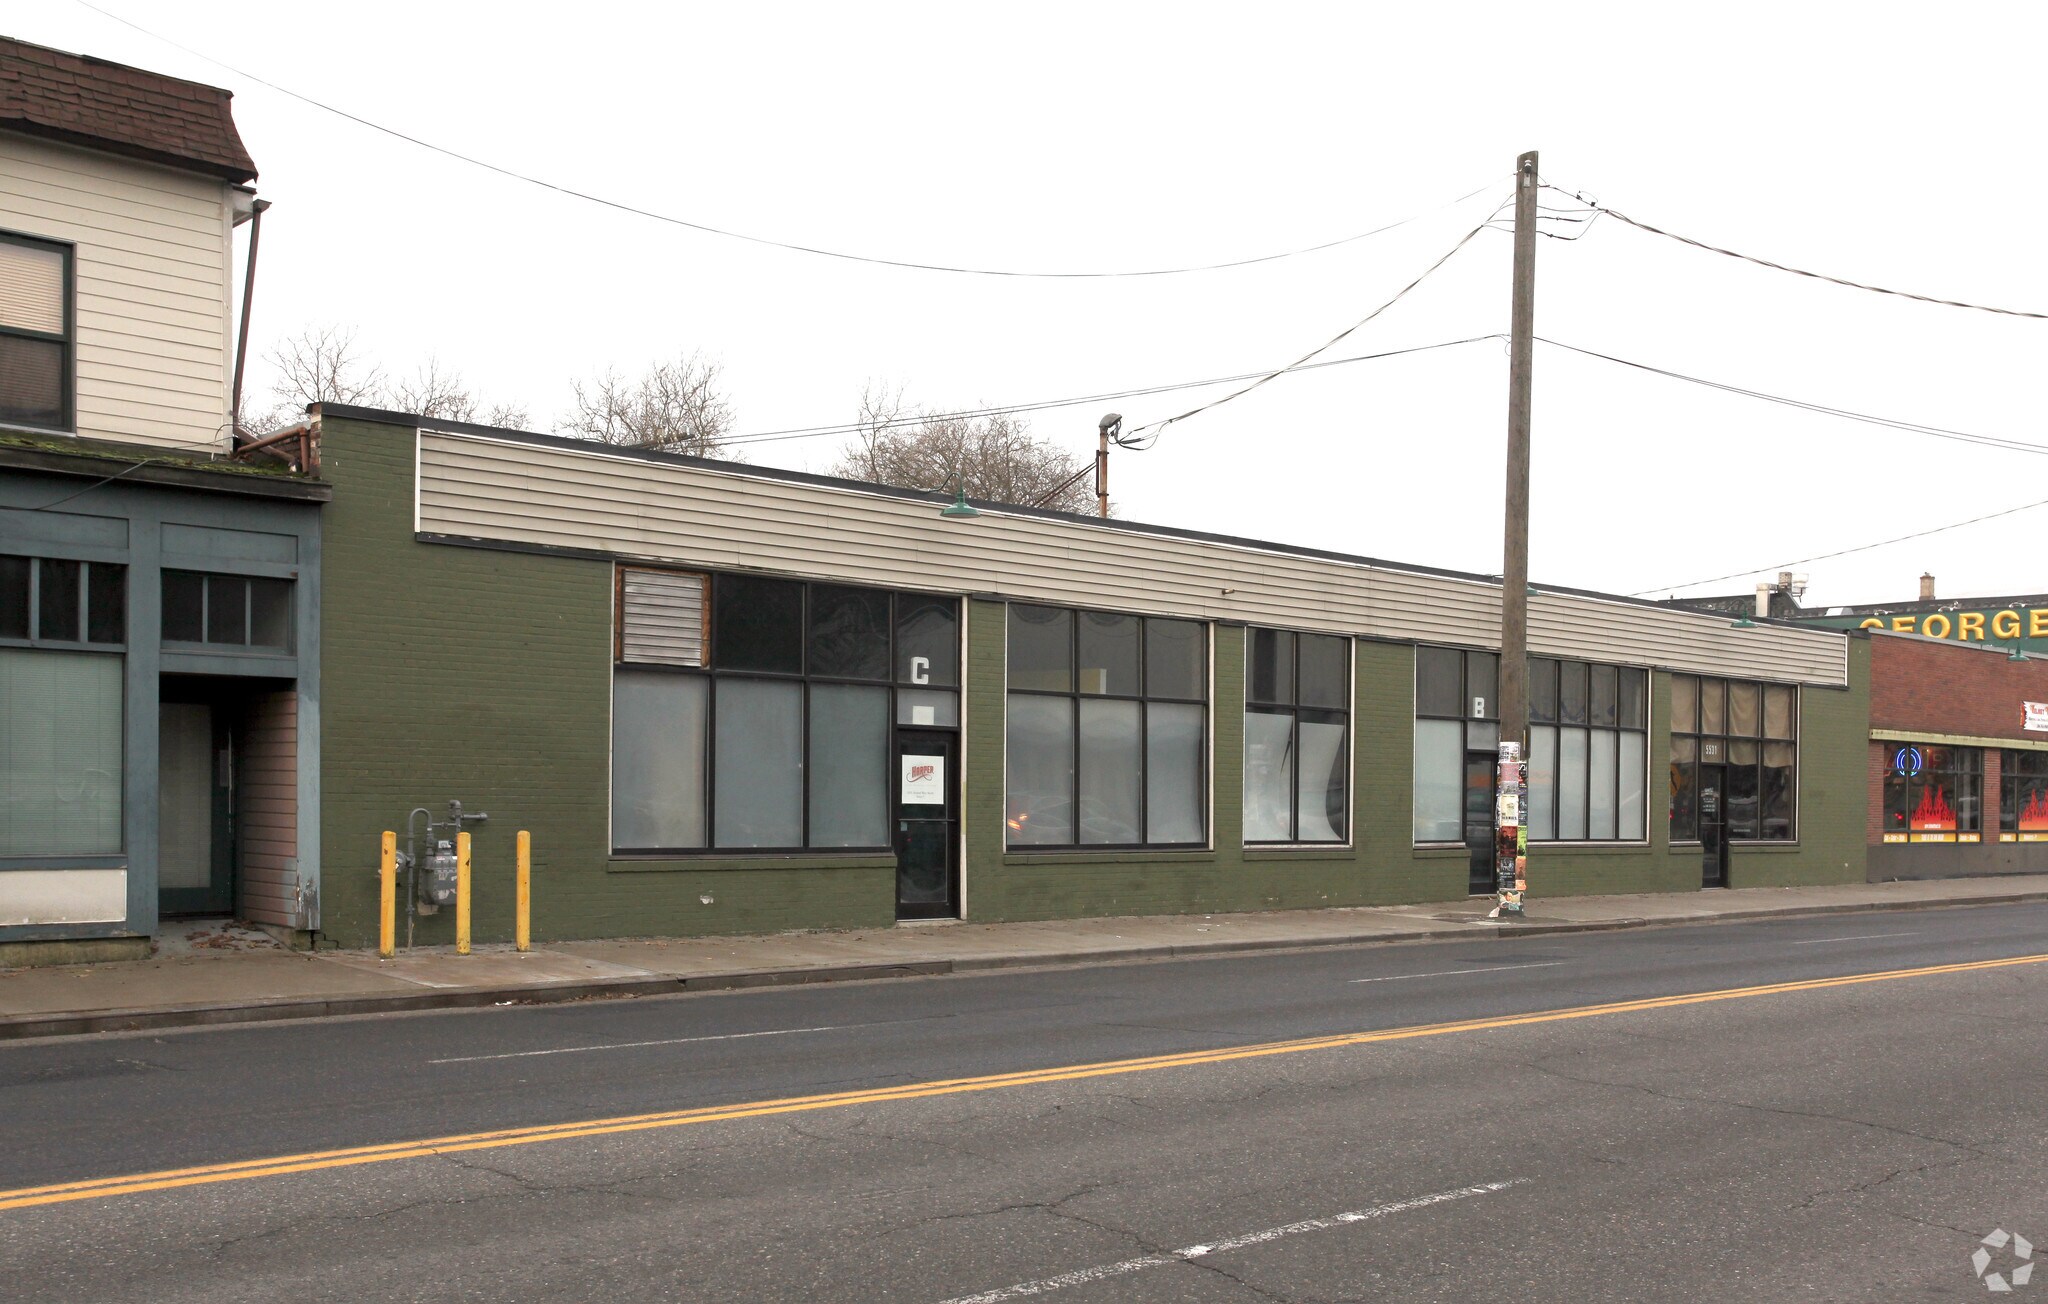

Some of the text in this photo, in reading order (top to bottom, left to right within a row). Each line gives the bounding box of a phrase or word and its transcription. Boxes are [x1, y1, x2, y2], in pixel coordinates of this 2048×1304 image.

[911, 656, 929, 684] C
[1474, 697, 1485, 718] B
[1705, 745, 1717, 755] 5531
